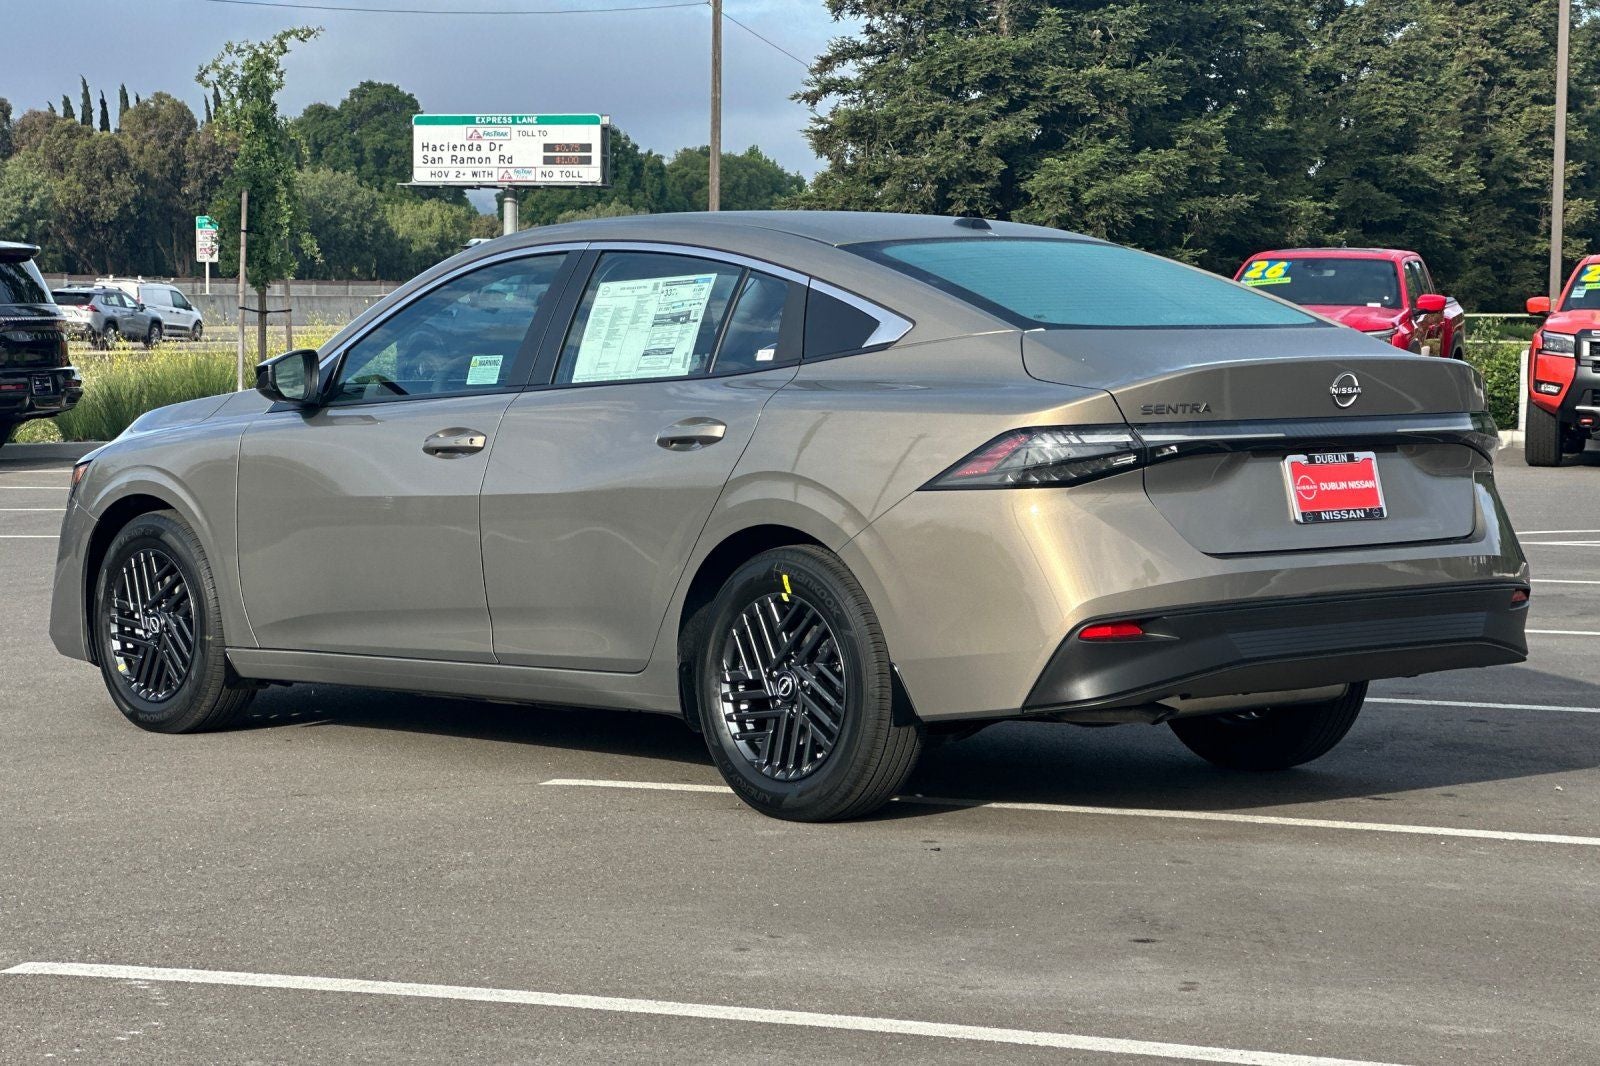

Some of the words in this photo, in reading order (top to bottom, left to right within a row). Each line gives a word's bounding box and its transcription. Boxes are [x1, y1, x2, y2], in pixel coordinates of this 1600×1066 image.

[475, 116, 512, 124] EXPRESS
[516, 116, 538, 124] LANE
[421, 142, 482, 152] Hacienda
[489, 142, 504, 152] Dr
[422, 155, 444, 164] San
[451, 155, 492, 164] Ramon
[499, 154, 513, 164] Rd
[430, 170, 450, 178] HOV
[471, 170, 493, 178] WITH
[540, 170, 554, 178] NO
[559, 170, 583, 178] TOLL
[1244, 260, 1287, 278] 26
[1581, 264, 1600, 282] 2
[1331, 386, 1362, 394] NISSAN
[1140, 402, 1212, 416] SENTRA
[1314, 454, 1348, 464] DUBLIN
[1319, 481, 1347, 491] DUBLIN
[1348, 479, 1375, 489] NISSAN
[1320, 509, 1365, 520] NISSAN
